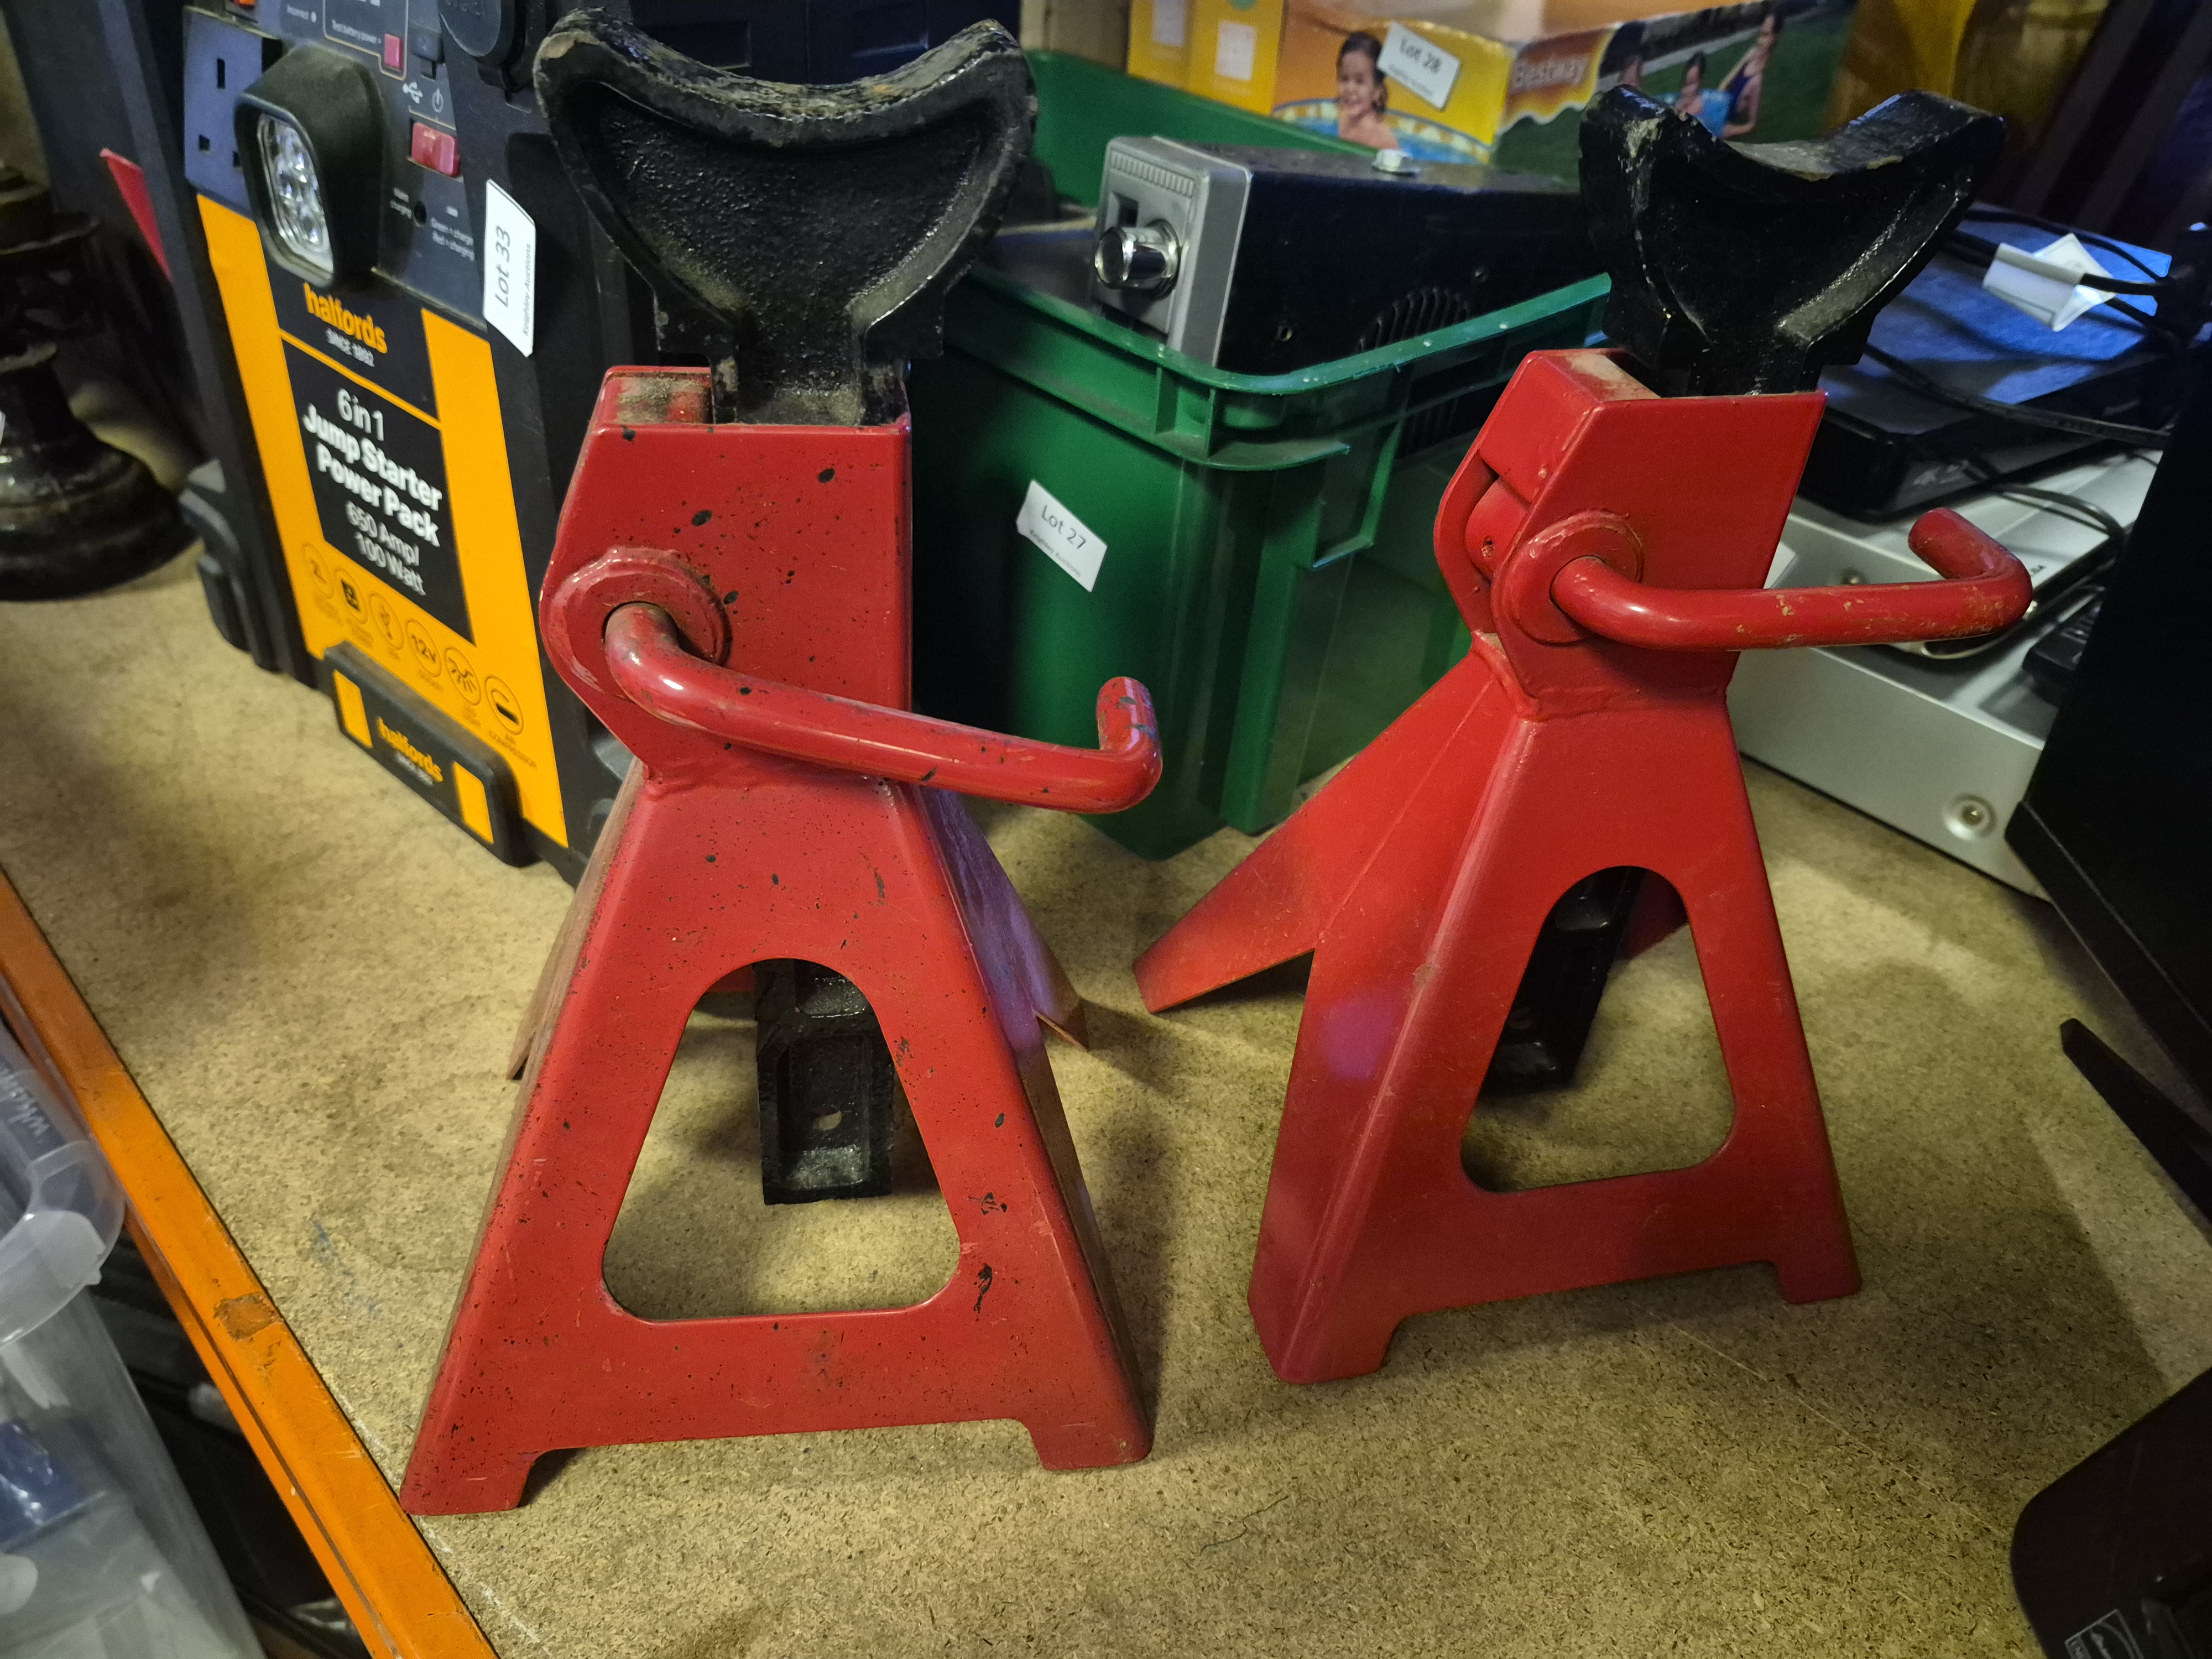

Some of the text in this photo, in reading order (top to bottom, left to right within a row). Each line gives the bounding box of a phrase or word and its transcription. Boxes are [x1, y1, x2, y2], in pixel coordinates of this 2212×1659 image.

[1399, 36, 1422, 63] Lot
[494, 225, 511, 309] Lot 33
[523, 243, 532, 293] Auctions
[303, 282, 388, 354] halfords
[302, 403, 443, 512] Jump Starter
[315, 441, 441, 547] Power Pack
[345, 500, 378, 539] 650
[1041, 505, 1087, 549] Lot 27
[354, 531, 426, 596] 100 Watt
[377, 716, 444, 783] halfords
